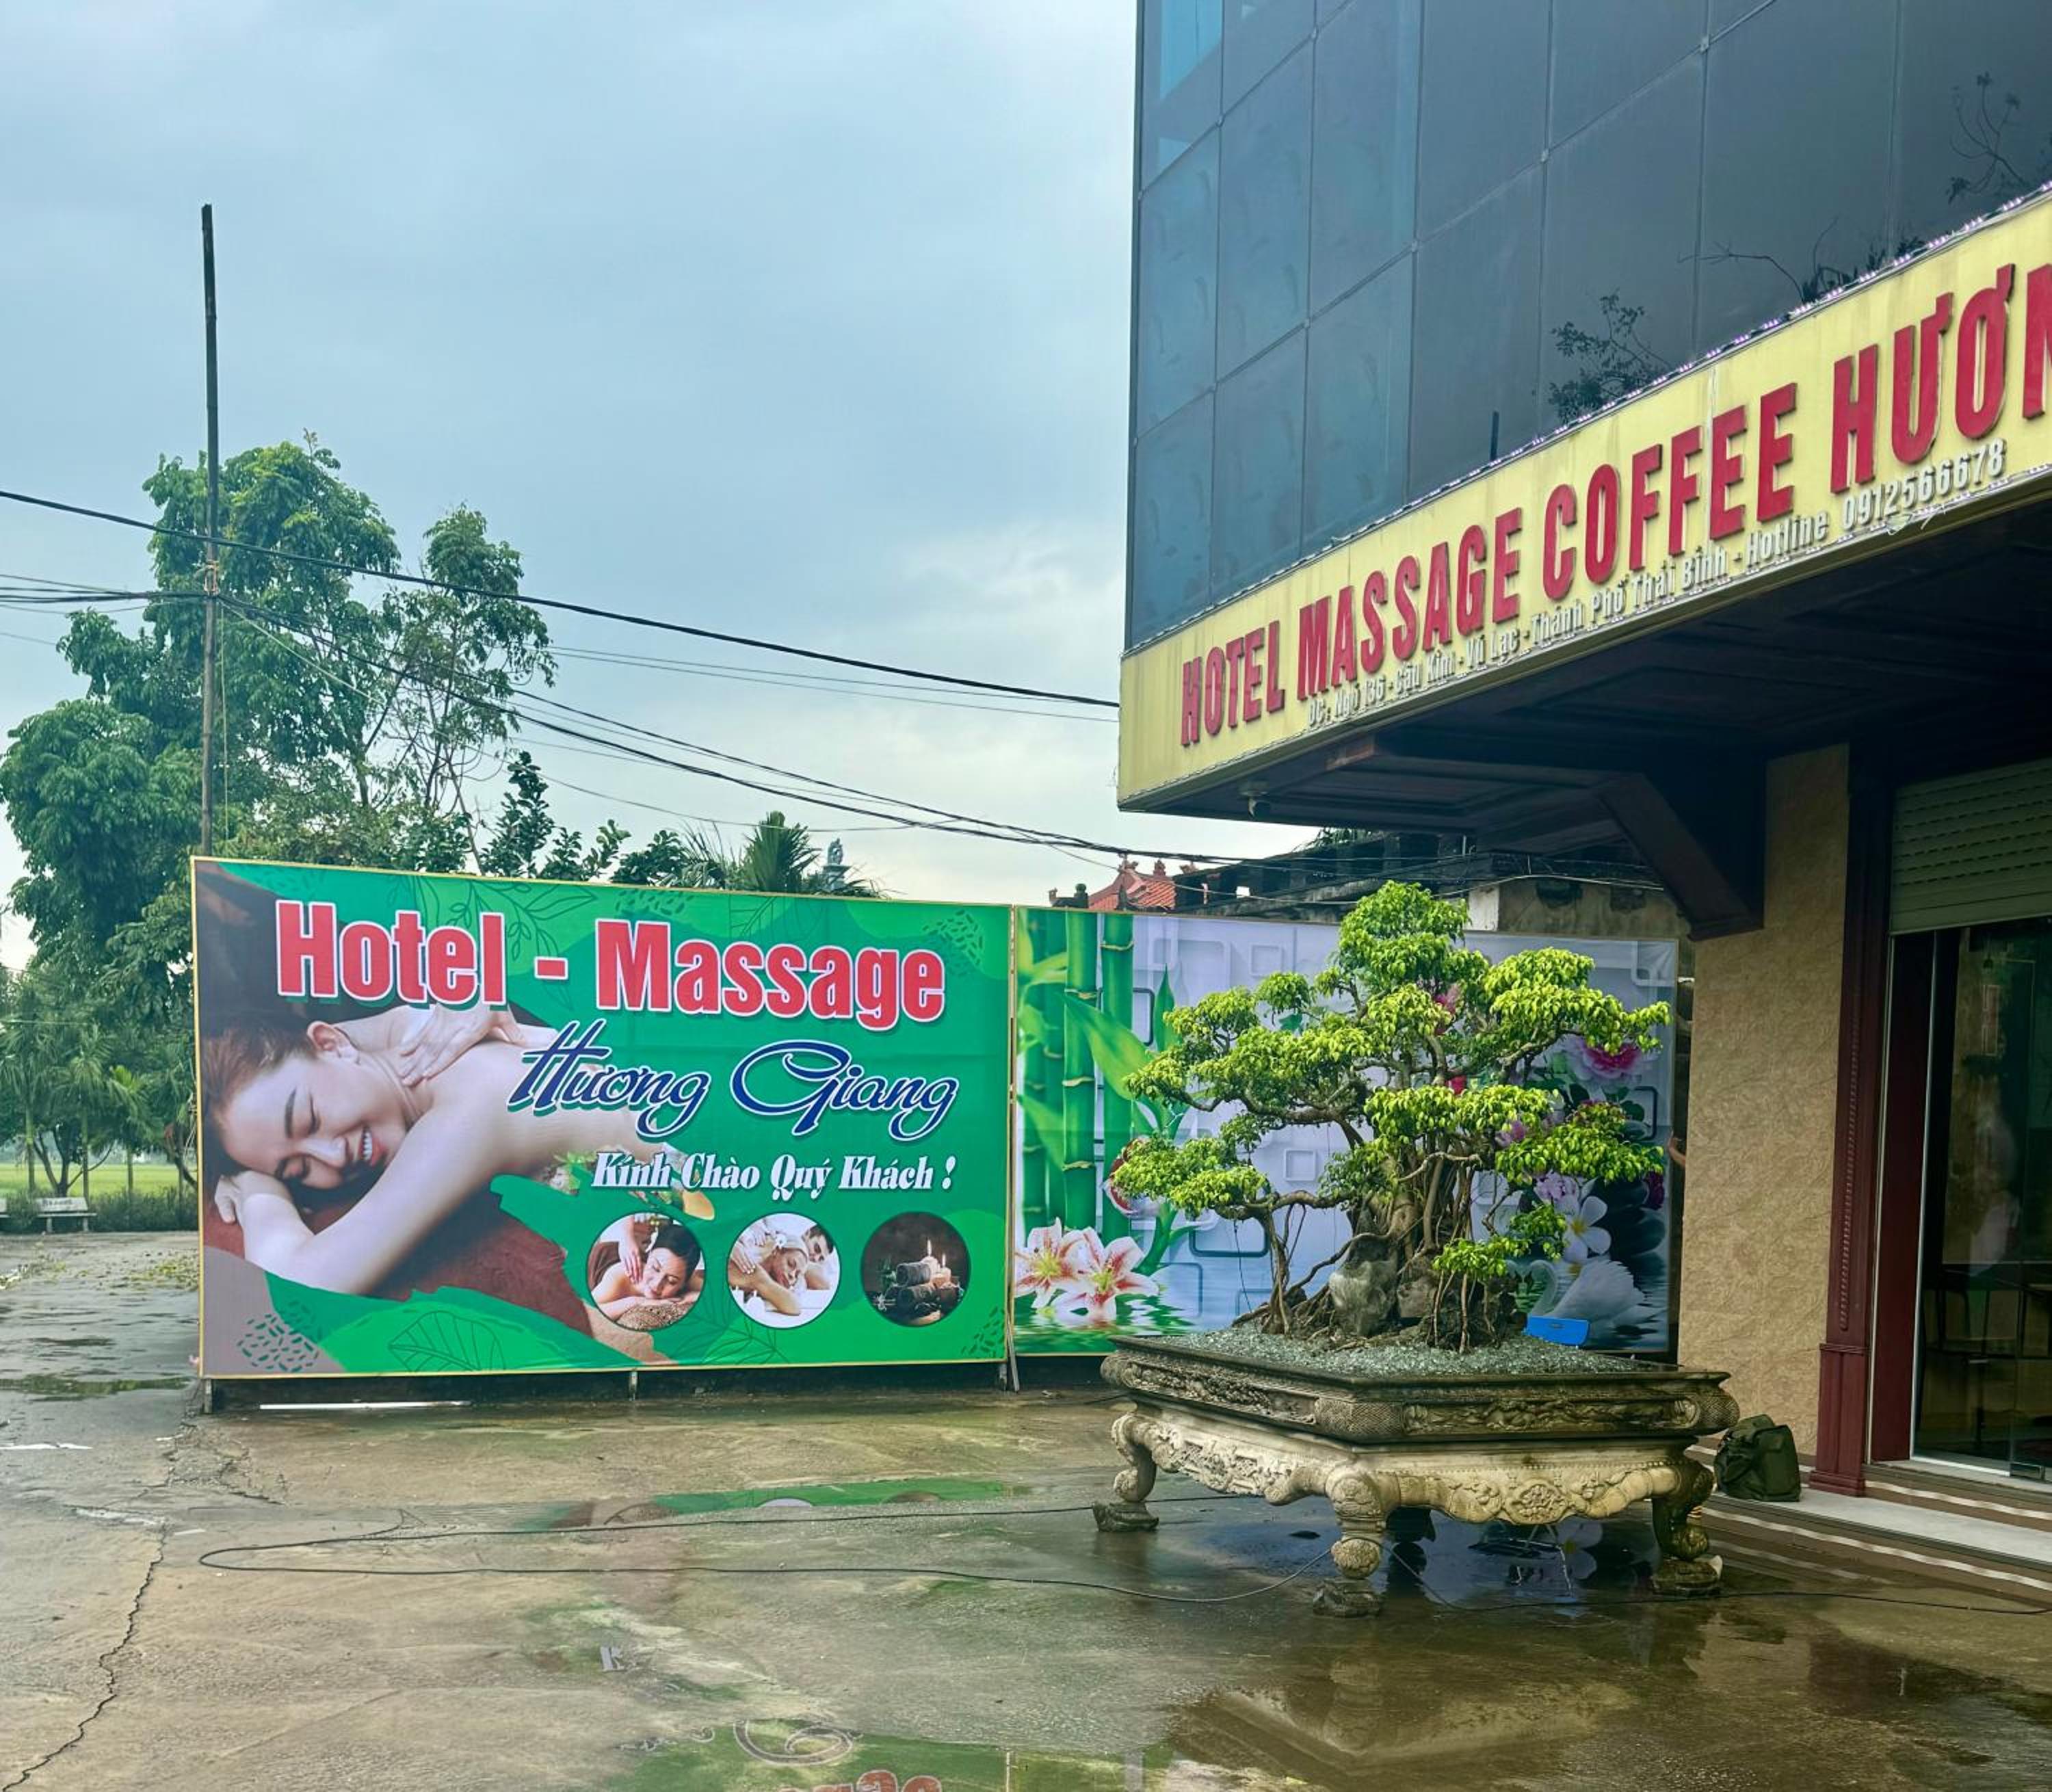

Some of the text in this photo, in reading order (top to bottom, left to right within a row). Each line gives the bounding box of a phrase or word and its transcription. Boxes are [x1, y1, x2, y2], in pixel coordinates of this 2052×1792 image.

[1181, 620, 1285, 747] HOTEL
[1298, 508, 1522, 700] MASSAGE
[1543, 382, 1798, 601] COFFEE
[1746, 511, 1829, 568] Hotline
[1841, 438, 2007, 531] 0912566678
[276, 899, 945, 1031] Hotel - Massage
[507, 1019, 960, 1142] Hương Giang
[590, 1152, 672, 1189] Kính
[681, 1153, 761, 1191] Chào
[770, 1154, 833, 1201] Quý
[838, 1155, 934, 1191] Khách
